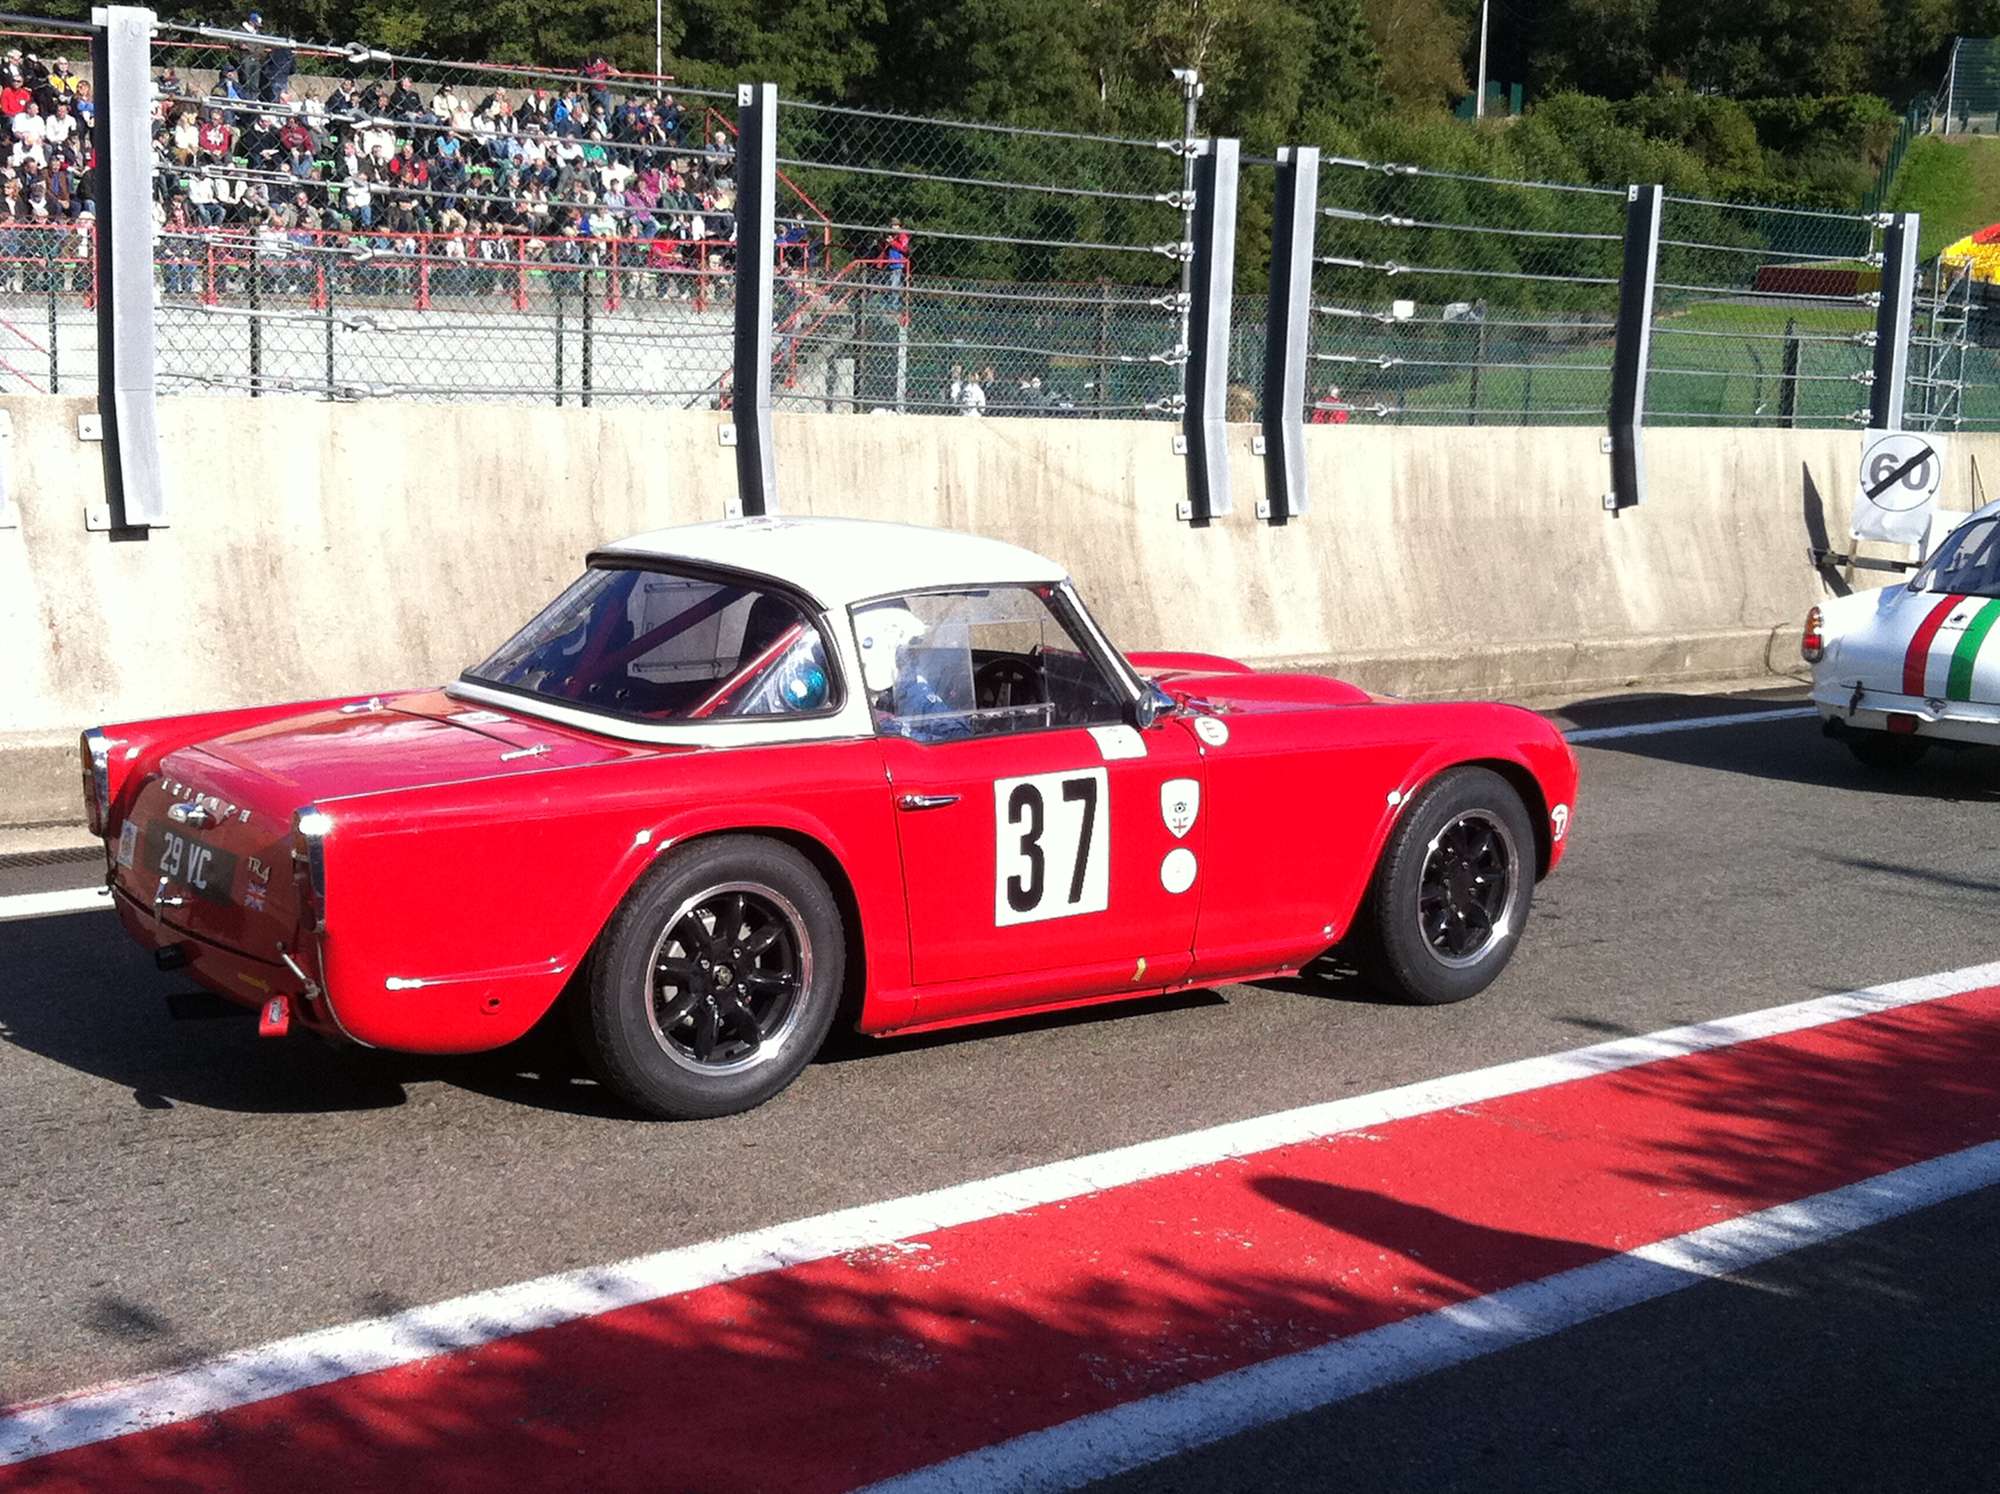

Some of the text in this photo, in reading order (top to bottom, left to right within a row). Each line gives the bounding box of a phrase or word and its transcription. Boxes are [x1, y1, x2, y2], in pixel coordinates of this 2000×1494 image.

[1869, 452, 1931, 491] 60
[159, 832, 183, 876] 29
[187, 843, 212, 890] VC
[1007, 776, 1097, 913] 37
